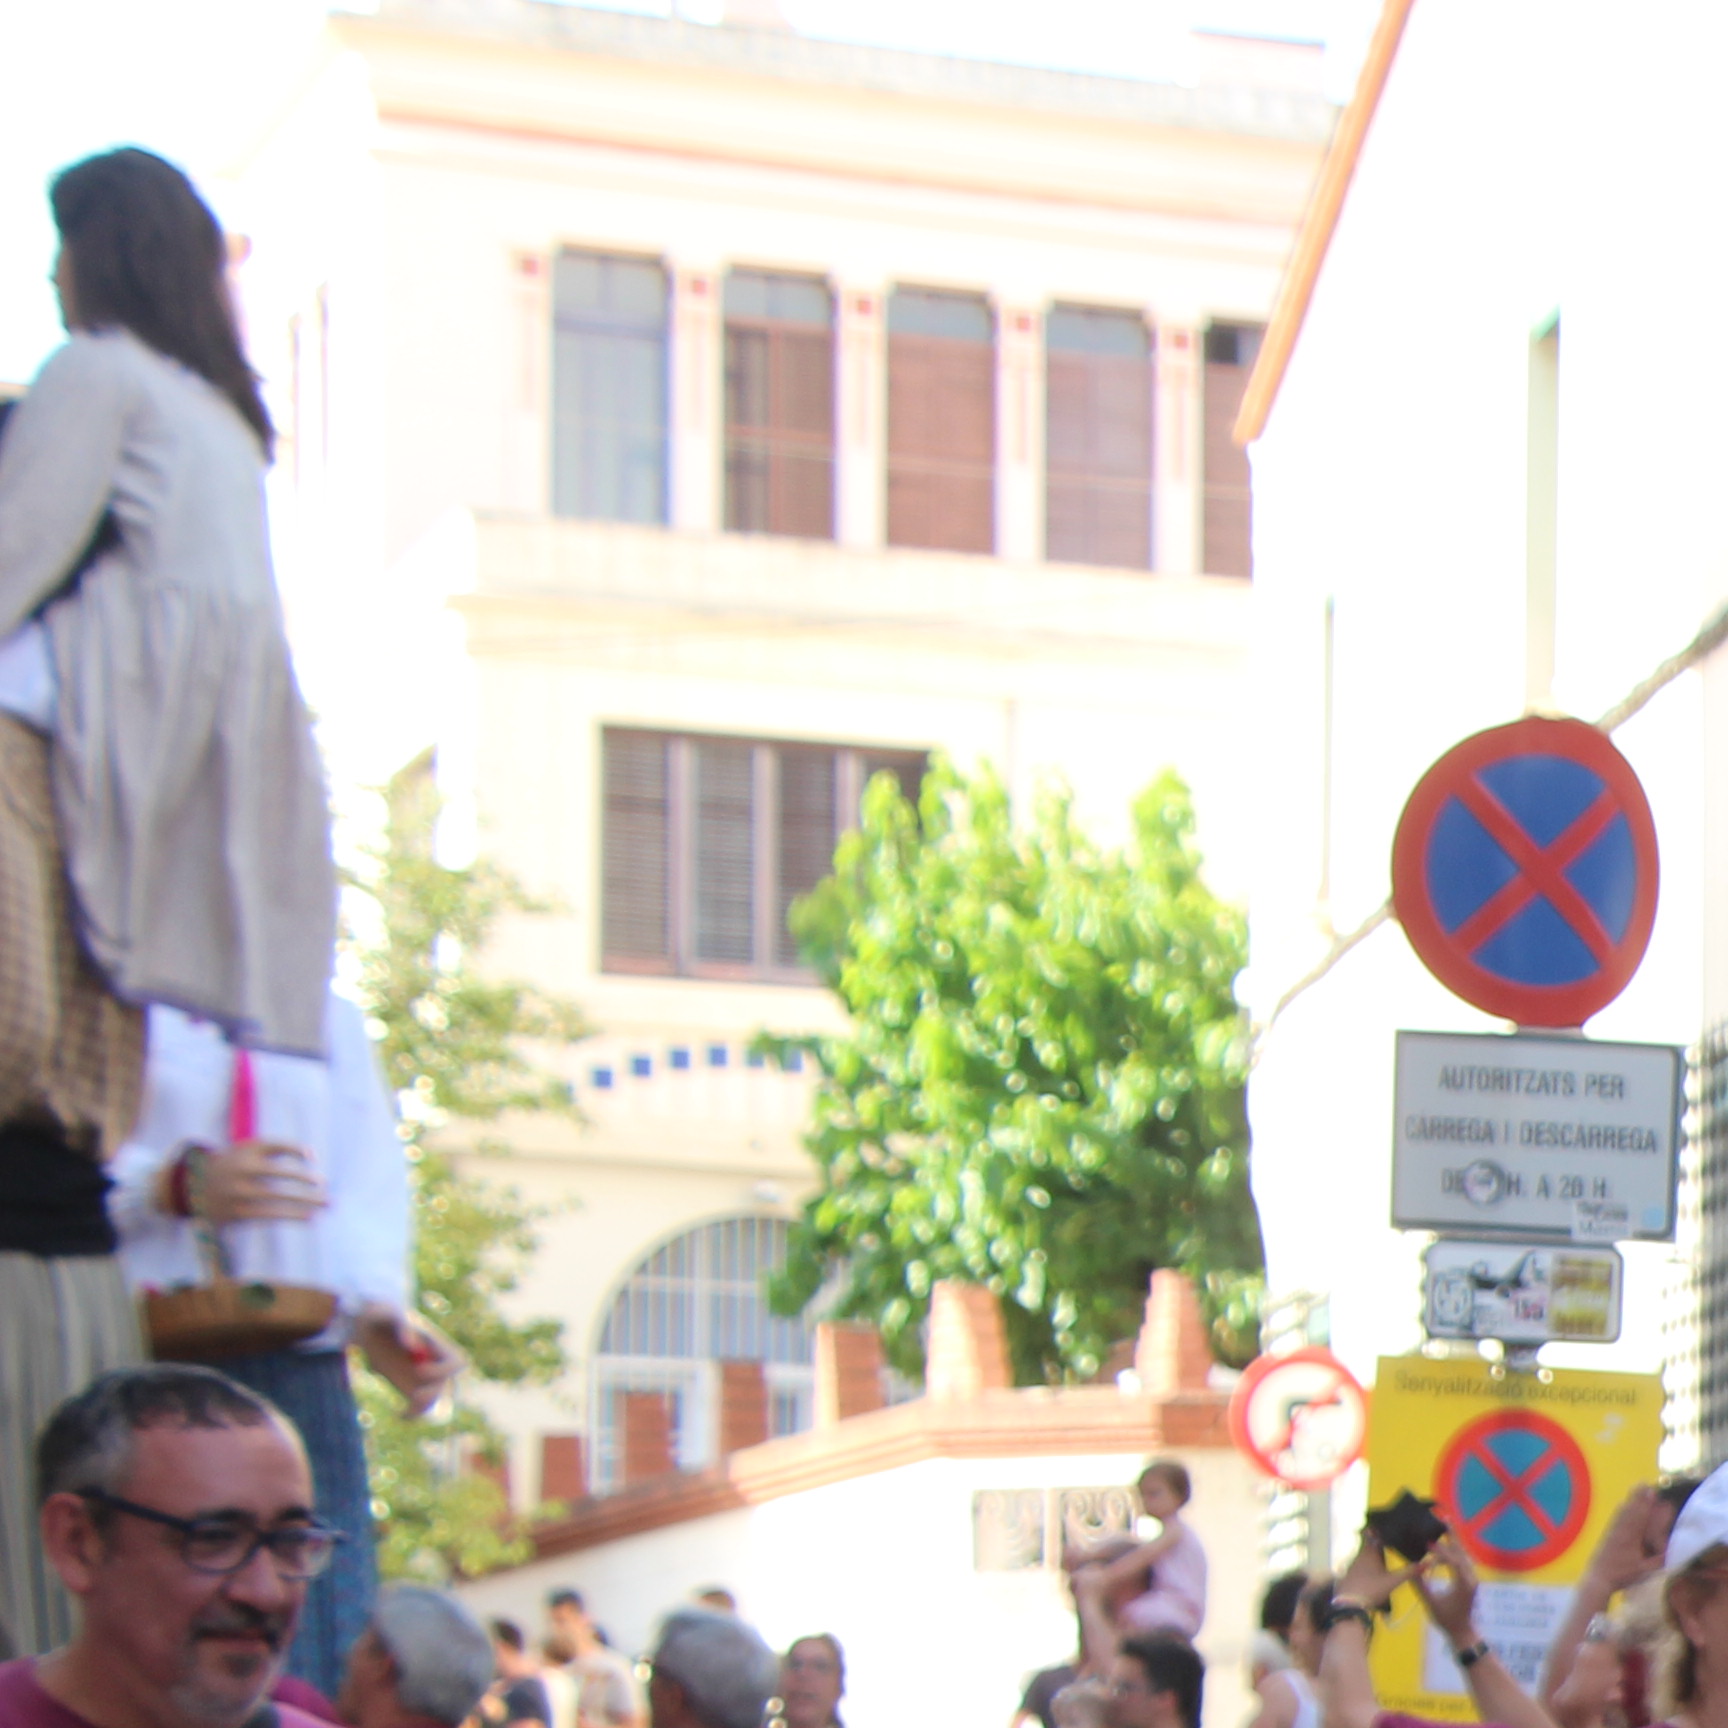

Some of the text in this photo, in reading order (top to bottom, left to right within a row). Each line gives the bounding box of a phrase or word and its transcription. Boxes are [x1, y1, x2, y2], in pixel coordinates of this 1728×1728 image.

[1438, 1066, 1625, 1099] AUTORITZATS PER
[1537, 1174, 1549, 1198] A
[1528, 1385, 1637, 1406] excepcional
